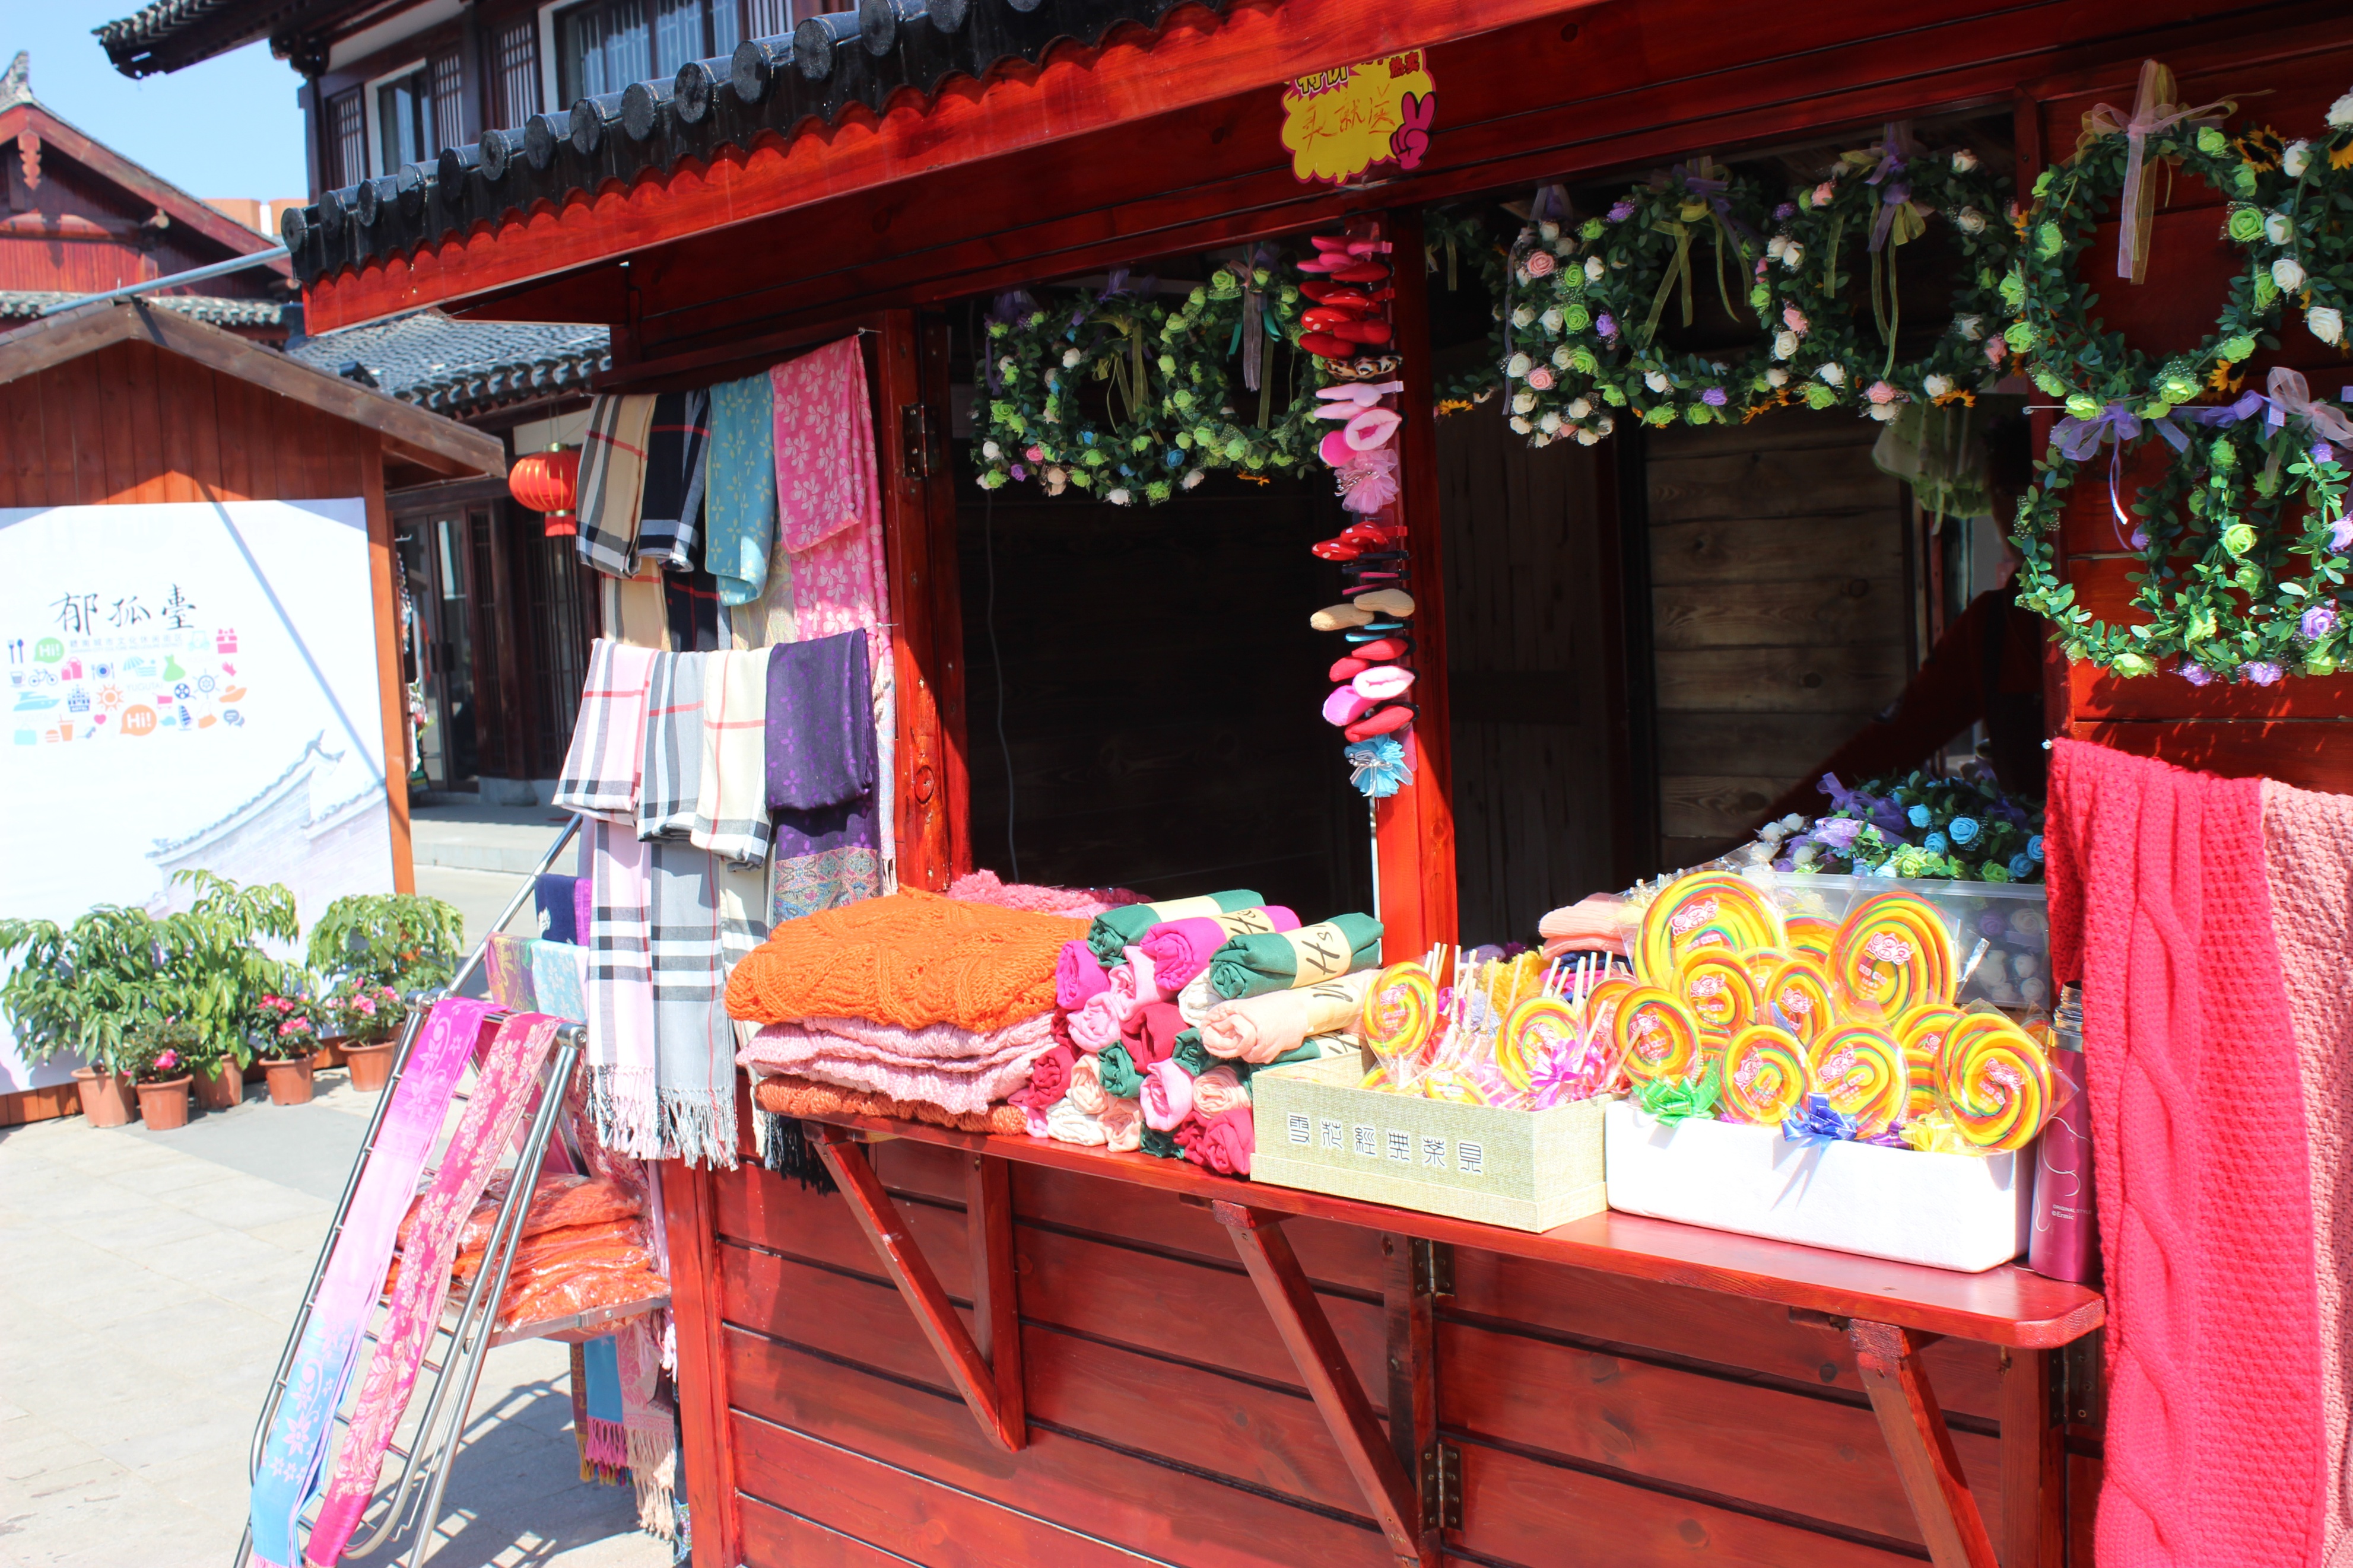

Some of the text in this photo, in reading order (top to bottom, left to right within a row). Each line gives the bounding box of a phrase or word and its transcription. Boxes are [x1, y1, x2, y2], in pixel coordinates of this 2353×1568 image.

[1389, 52, 1420, 79] 热卖
[39, 643, 61, 657] Hi!
[126, 711, 151, 729] Hi!
[2052, 1204, 2076, 1213] ORIGINAL
